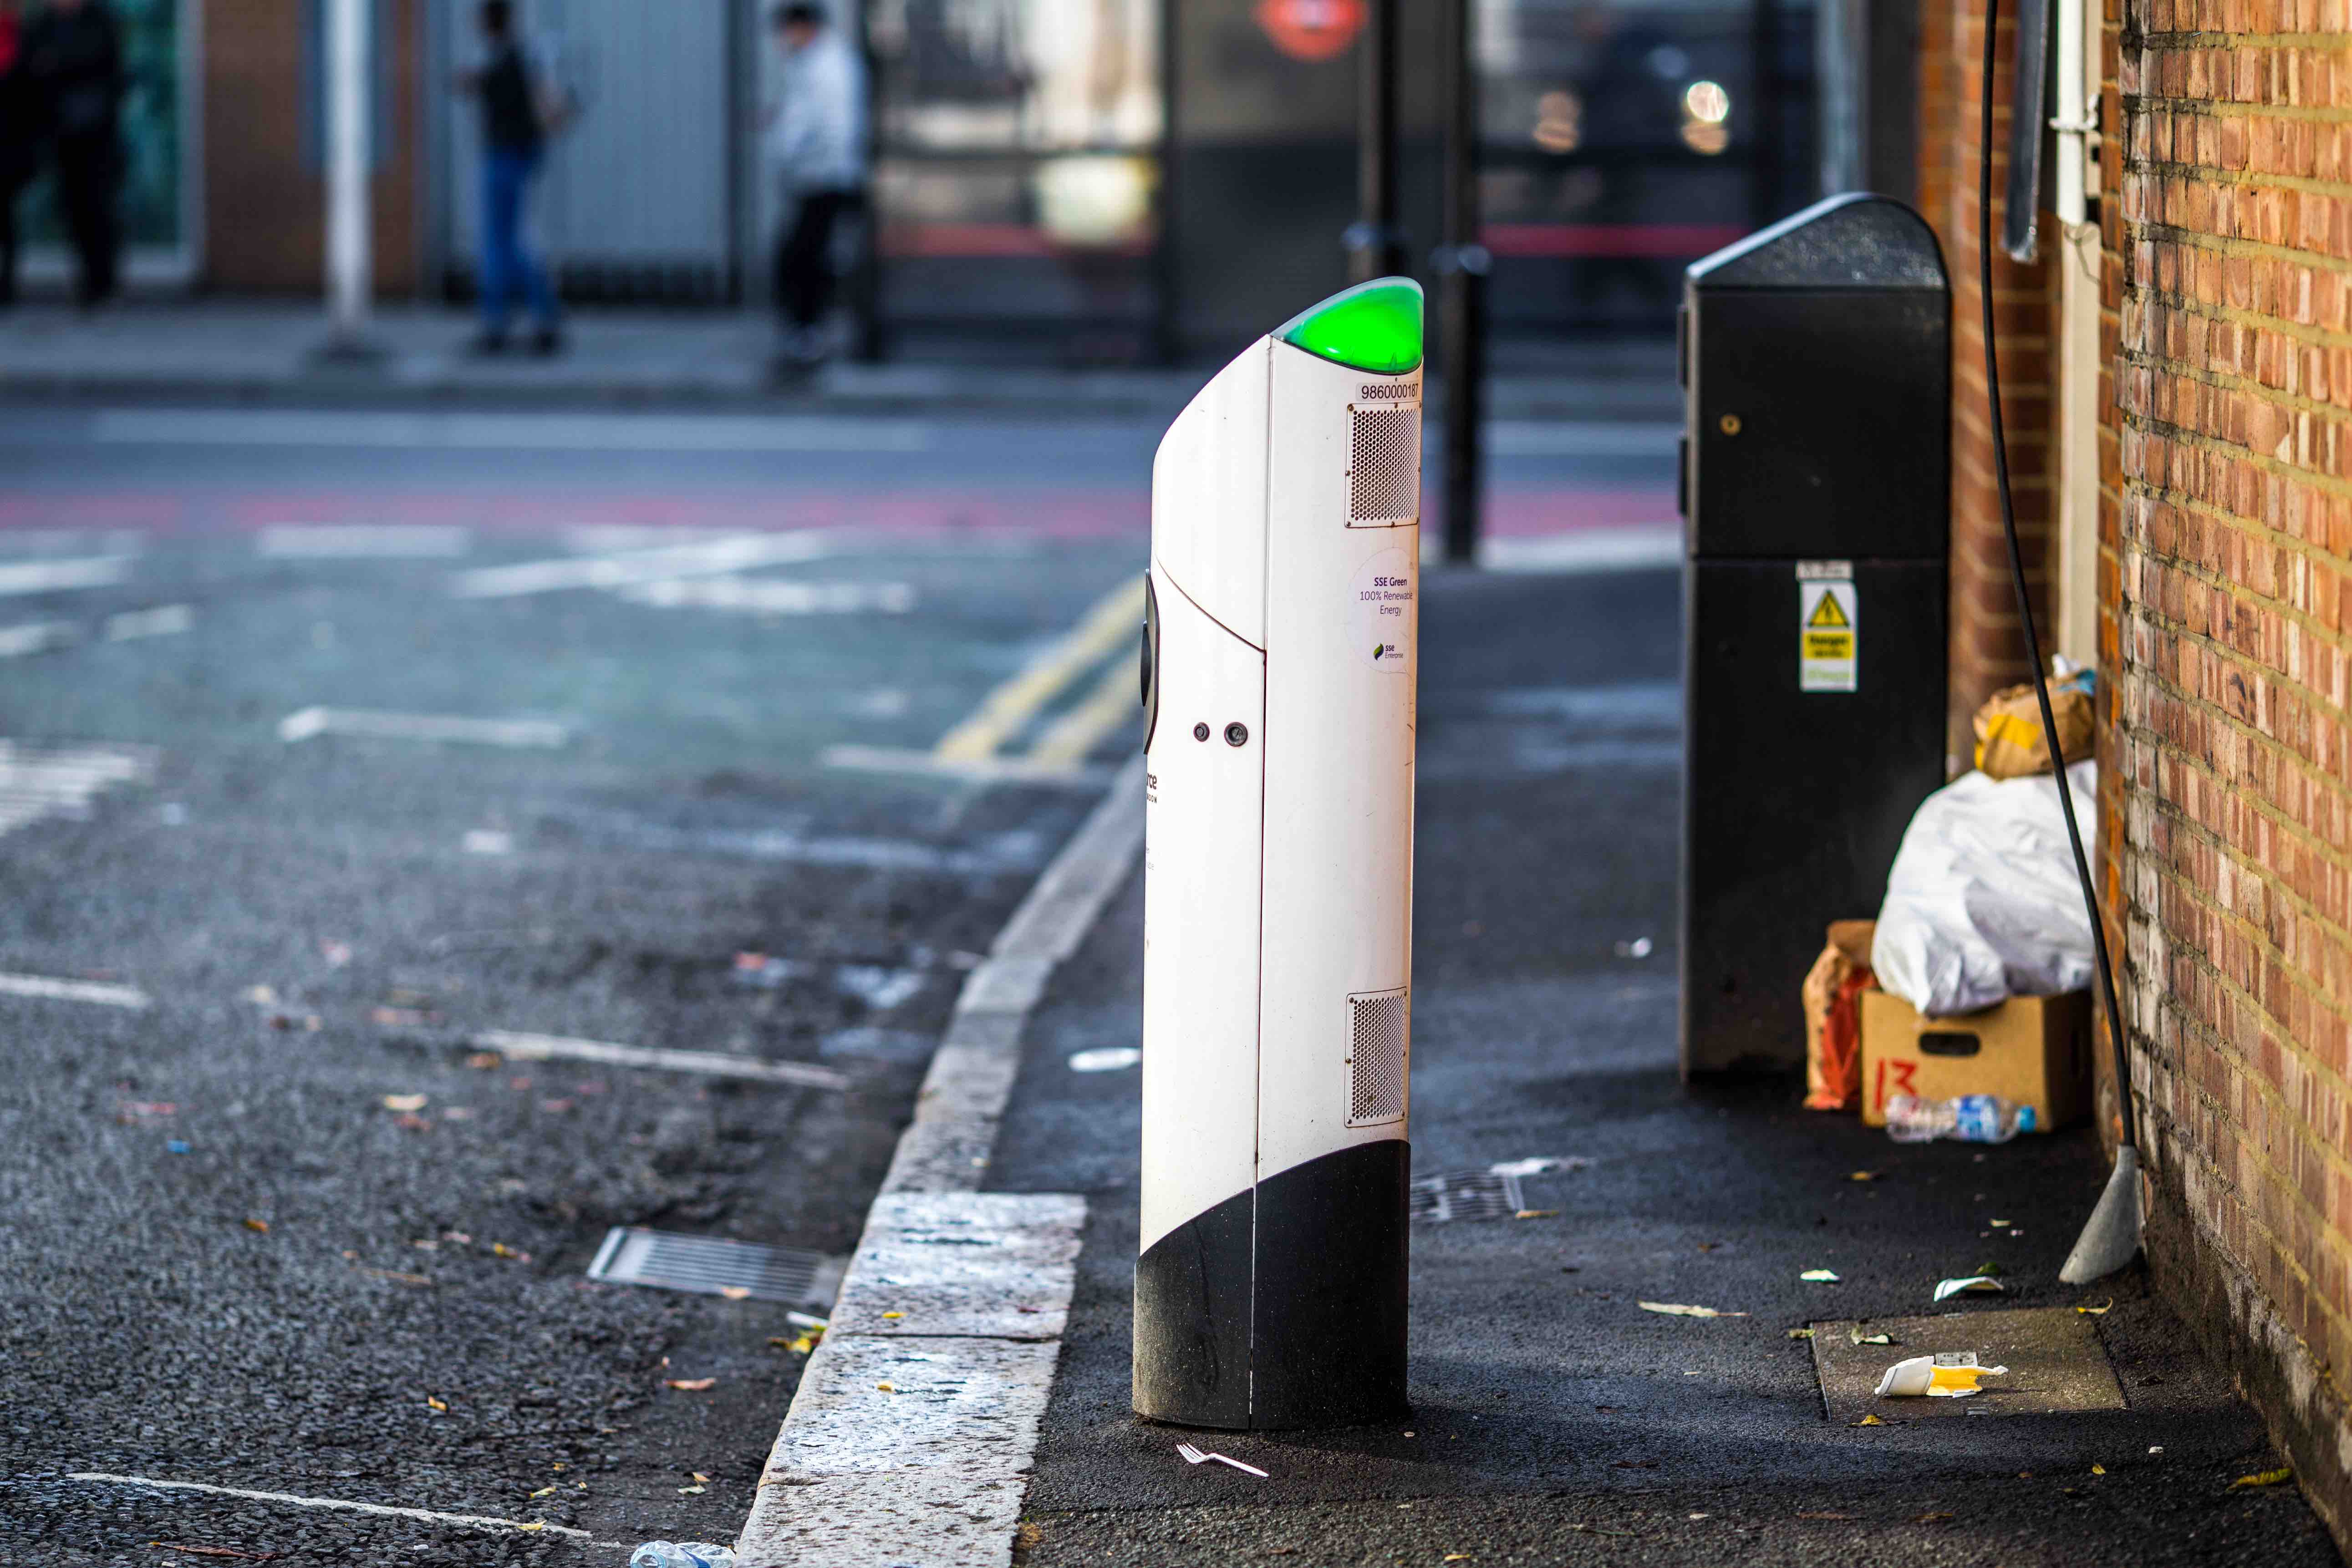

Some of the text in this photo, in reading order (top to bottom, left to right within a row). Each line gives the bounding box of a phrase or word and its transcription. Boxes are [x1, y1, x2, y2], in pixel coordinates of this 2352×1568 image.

[1361, 383, 1418, 399] 9860000187
[1374, 577, 1407, 587] SSE Green
[1360, 591, 1413, 601] 100% Renewable
[1380, 605, 1402, 616] Energy
[1146, 773, 1157, 789] rce
[1873, 1057, 1918, 1112] 13
